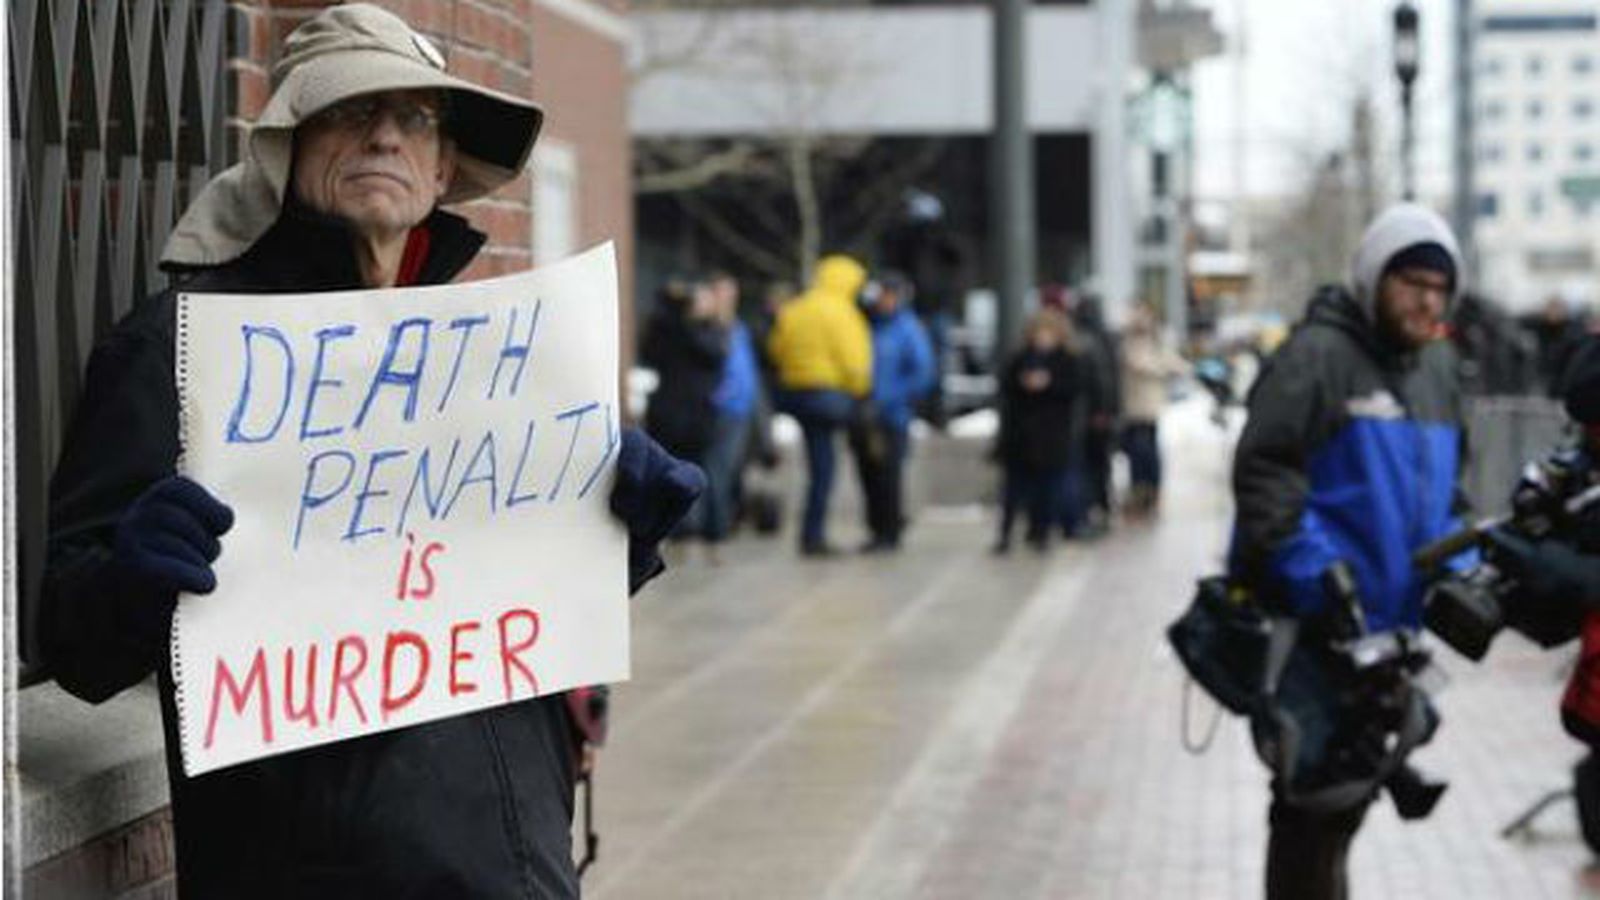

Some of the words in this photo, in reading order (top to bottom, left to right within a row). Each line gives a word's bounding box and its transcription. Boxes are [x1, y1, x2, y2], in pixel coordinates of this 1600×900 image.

[226, 299, 541, 443] DEATH
[293, 402, 620, 550] PENALTY
[396, 533, 445, 600] is
[204, 609, 540, 749] MURDER
